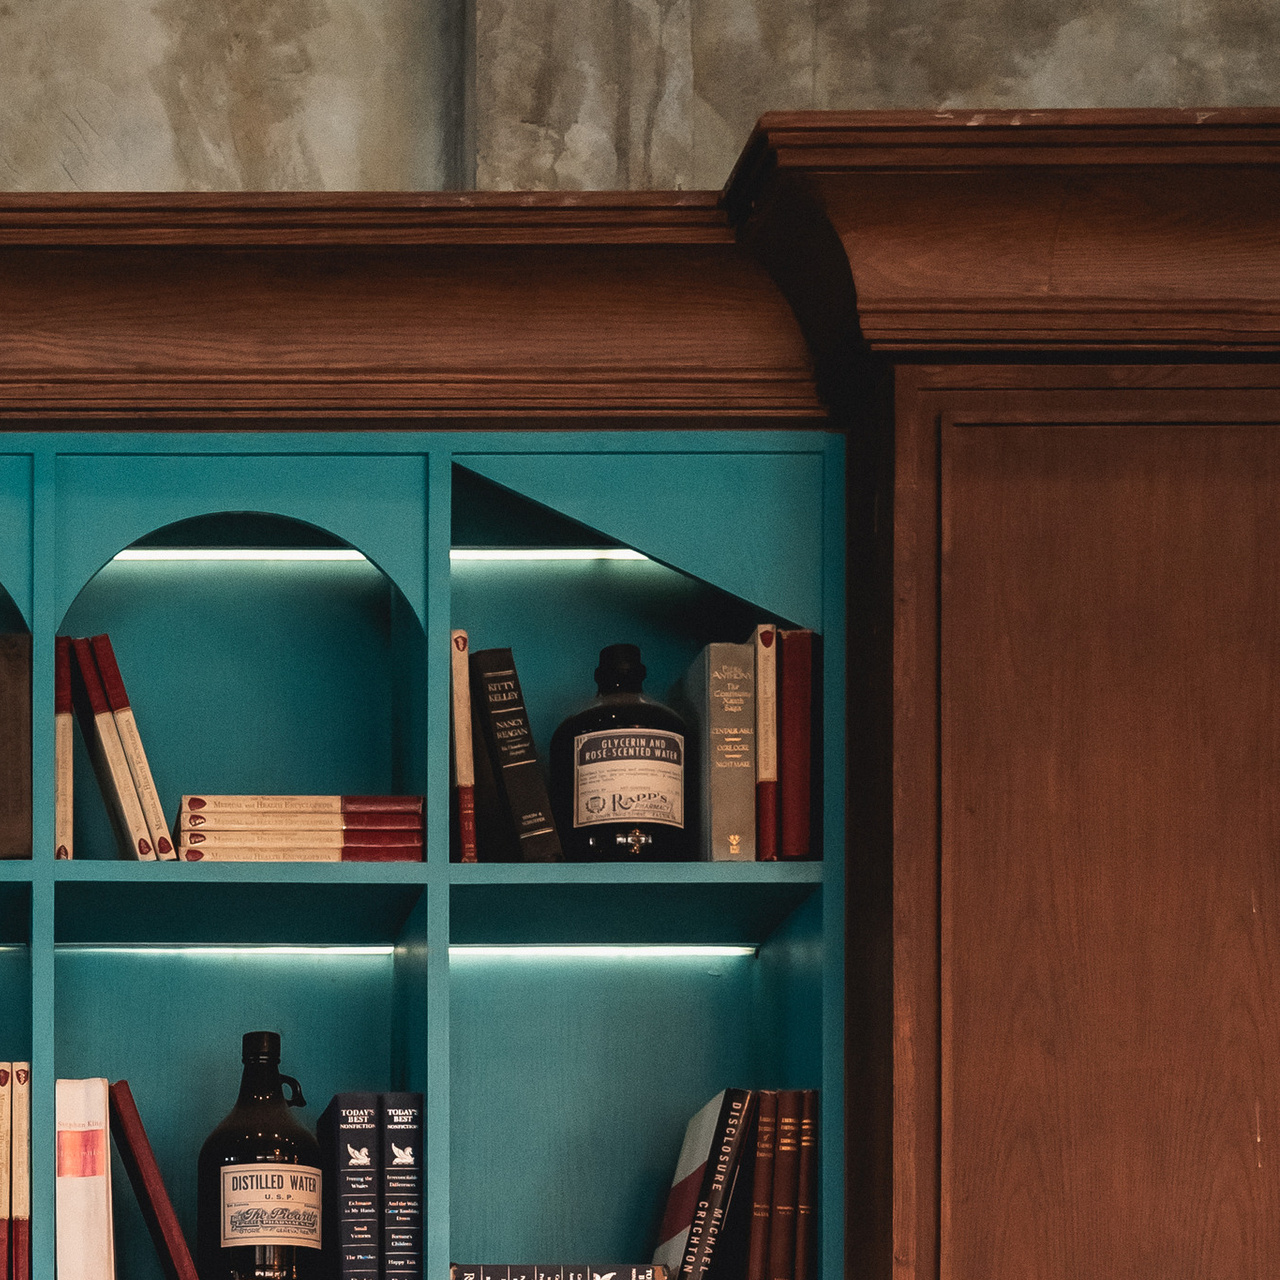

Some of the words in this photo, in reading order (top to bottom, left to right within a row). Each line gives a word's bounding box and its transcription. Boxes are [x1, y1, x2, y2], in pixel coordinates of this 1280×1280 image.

[488, 681, 515, 692] KITTY
[488, 691, 519, 702] KELLEY
[495, 719, 524, 729] NANCY
[496, 728, 528, 739] REAGAN
[601, 738, 646, 748] GLYCERIN
[649, 738, 666, 748] AND
[585, 747, 651, 760] ROSE-SCENTED
[654, 748, 678, 760] WATER
[341, 1108, 375, 1116] TODAY'S
[387, 1108, 418, 1116] TODAY'S
[712, 1102, 742, 1191] DISCLOSURE
[231, 1174, 284, 1191] DISTILLED
[290, 1174, 317, 1193] WATER
[683, 1201, 708, 1273] CRICHTON
[699, 1208, 723, 1273] MICHAEL
